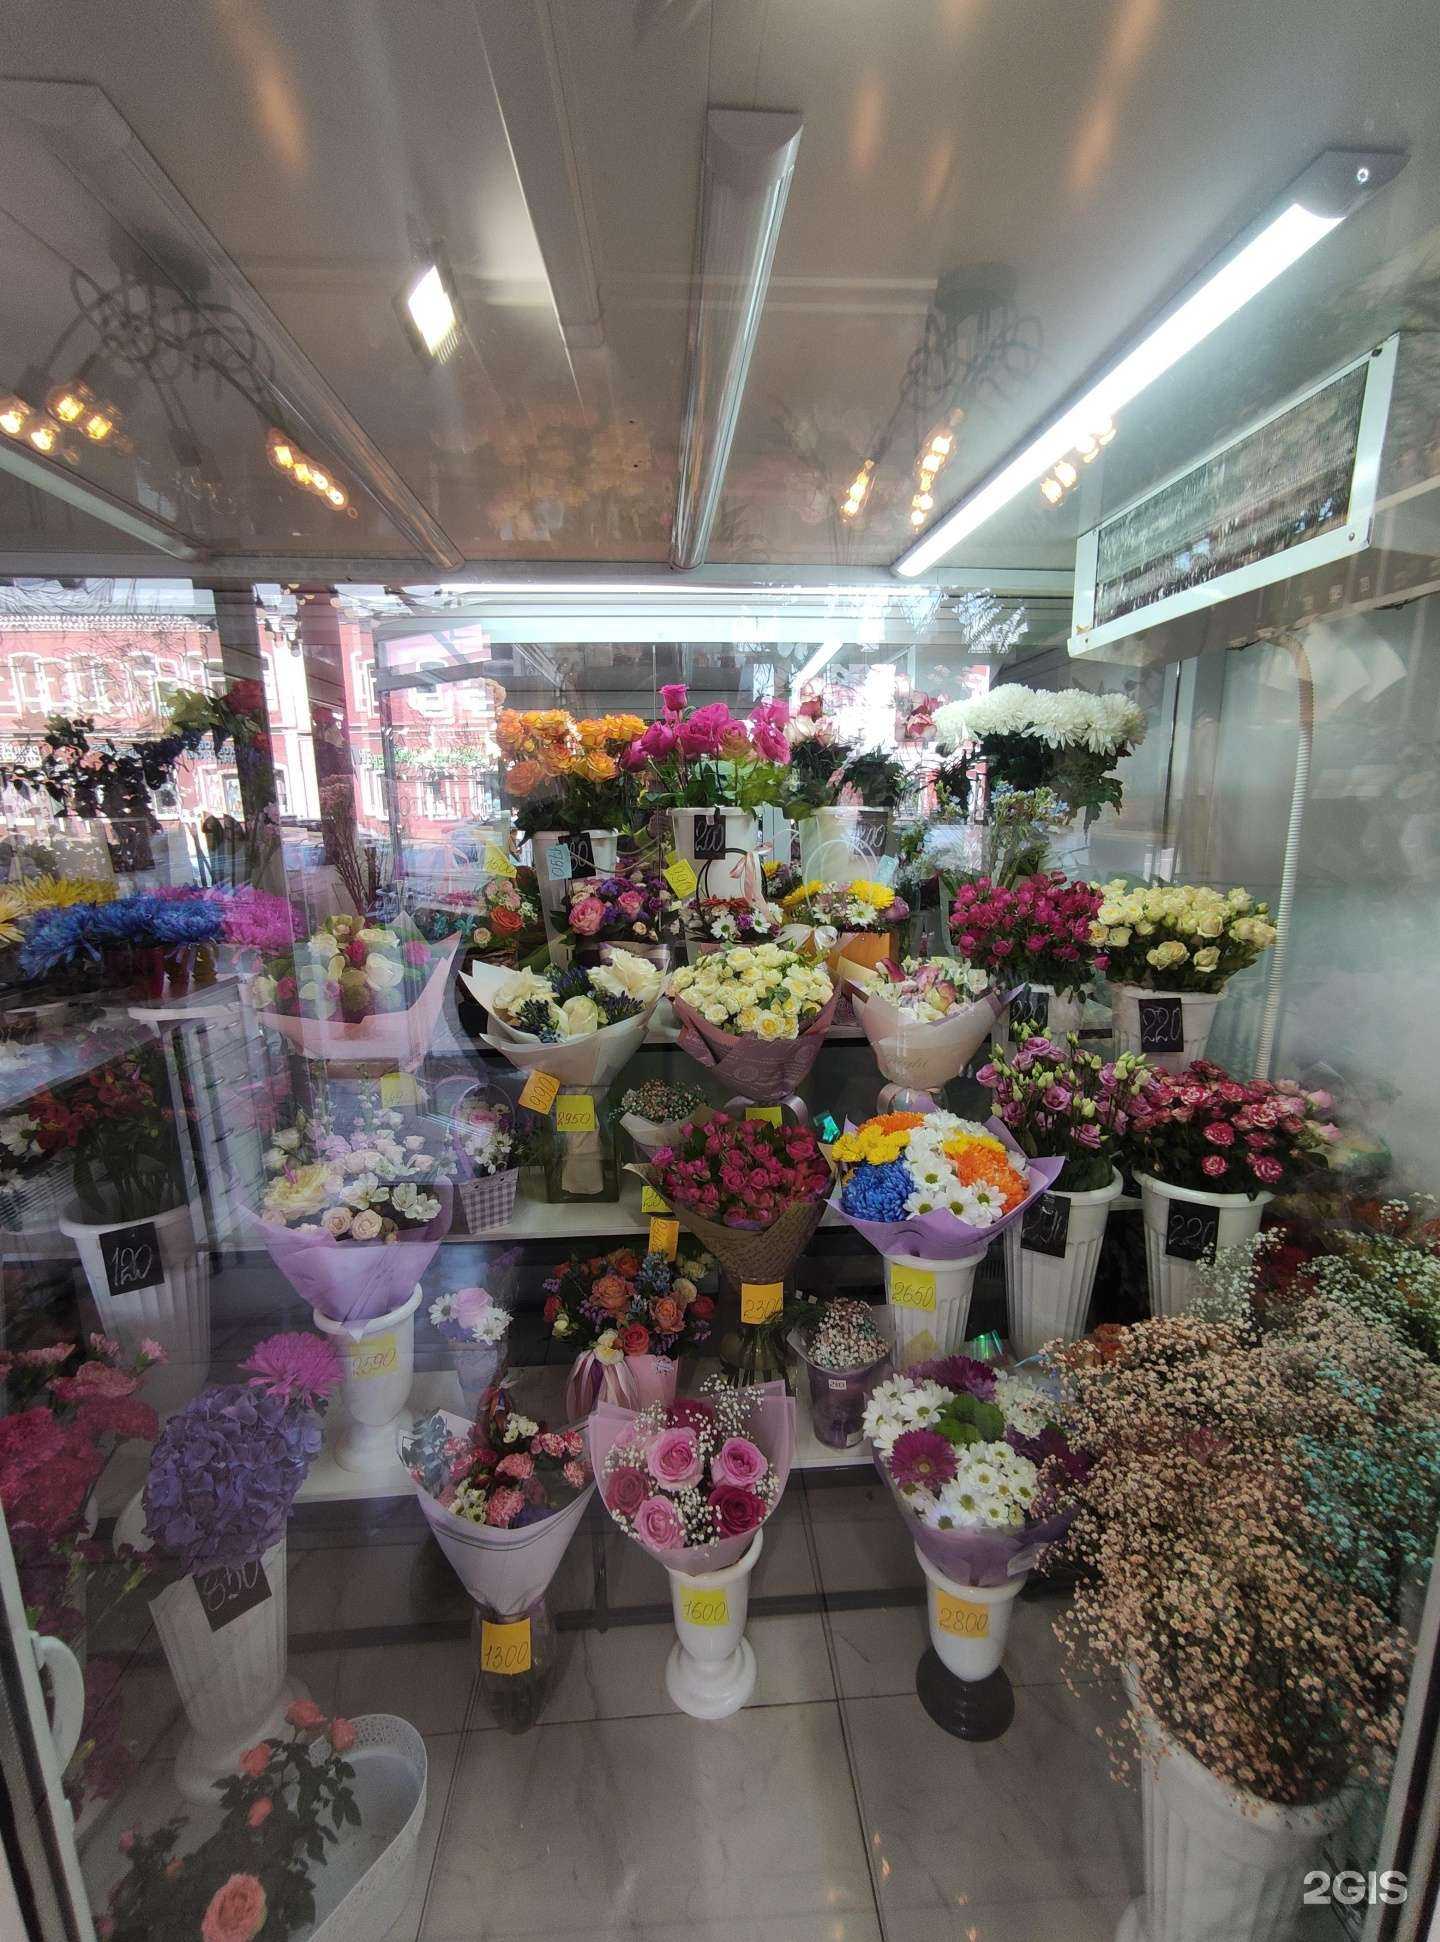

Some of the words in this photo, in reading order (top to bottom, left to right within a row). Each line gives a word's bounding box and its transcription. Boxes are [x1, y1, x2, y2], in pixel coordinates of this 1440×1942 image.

[1143, 1007, 1180, 1043] 220
[111, 1244, 152, 1286] 120
[892, 1281, 934, 1308] 2650
[686, 1600, 726, 1620] 1600
[939, 1607, 988, 1632] 2800
[487, 1641, 528, 1668] 1300
